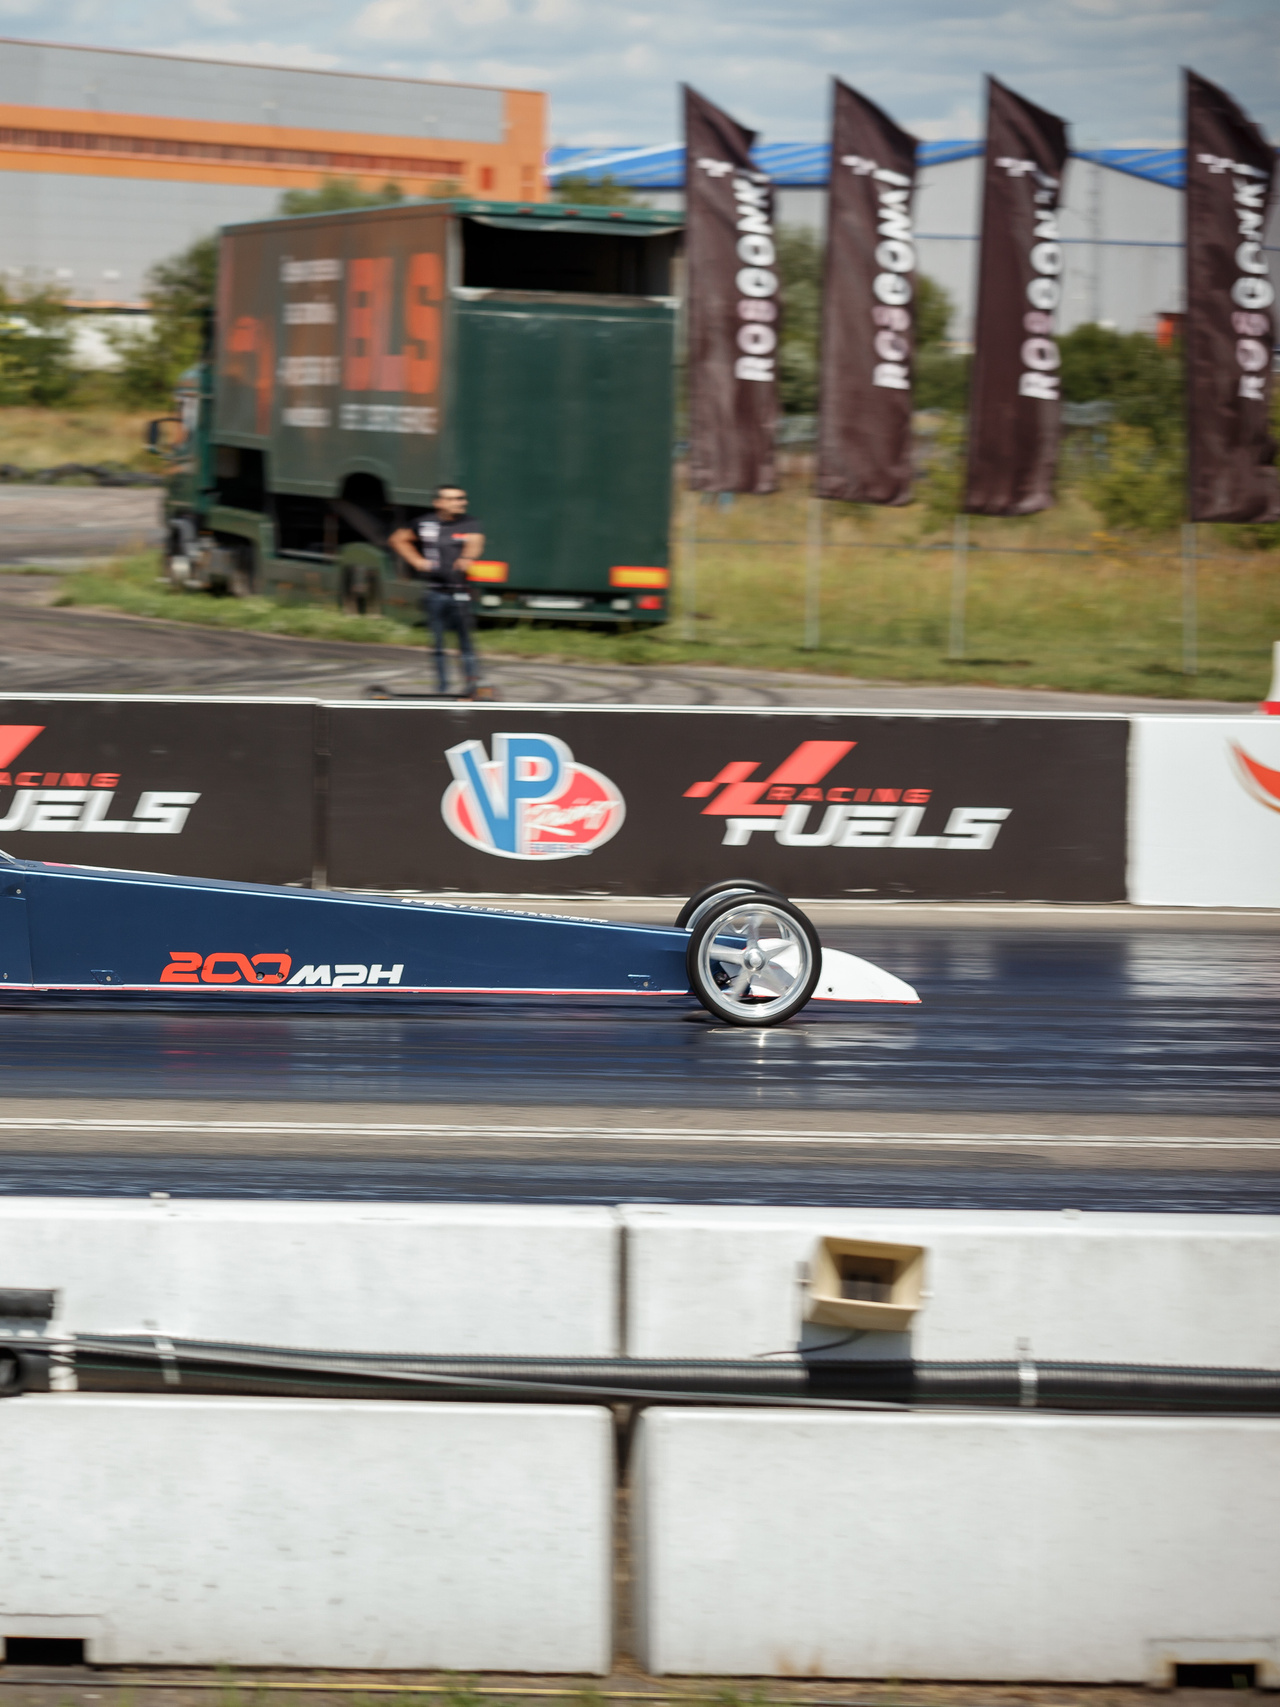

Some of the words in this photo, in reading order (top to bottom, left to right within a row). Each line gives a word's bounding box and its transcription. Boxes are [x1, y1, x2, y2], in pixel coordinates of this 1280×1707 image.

[444, 732, 576, 855] VP
[766, 786, 933, 804] RACING
[721, 803, 1014, 850] FUELS
[159, 951, 293, 985] 200
[286, 964, 405, 988] MPH
